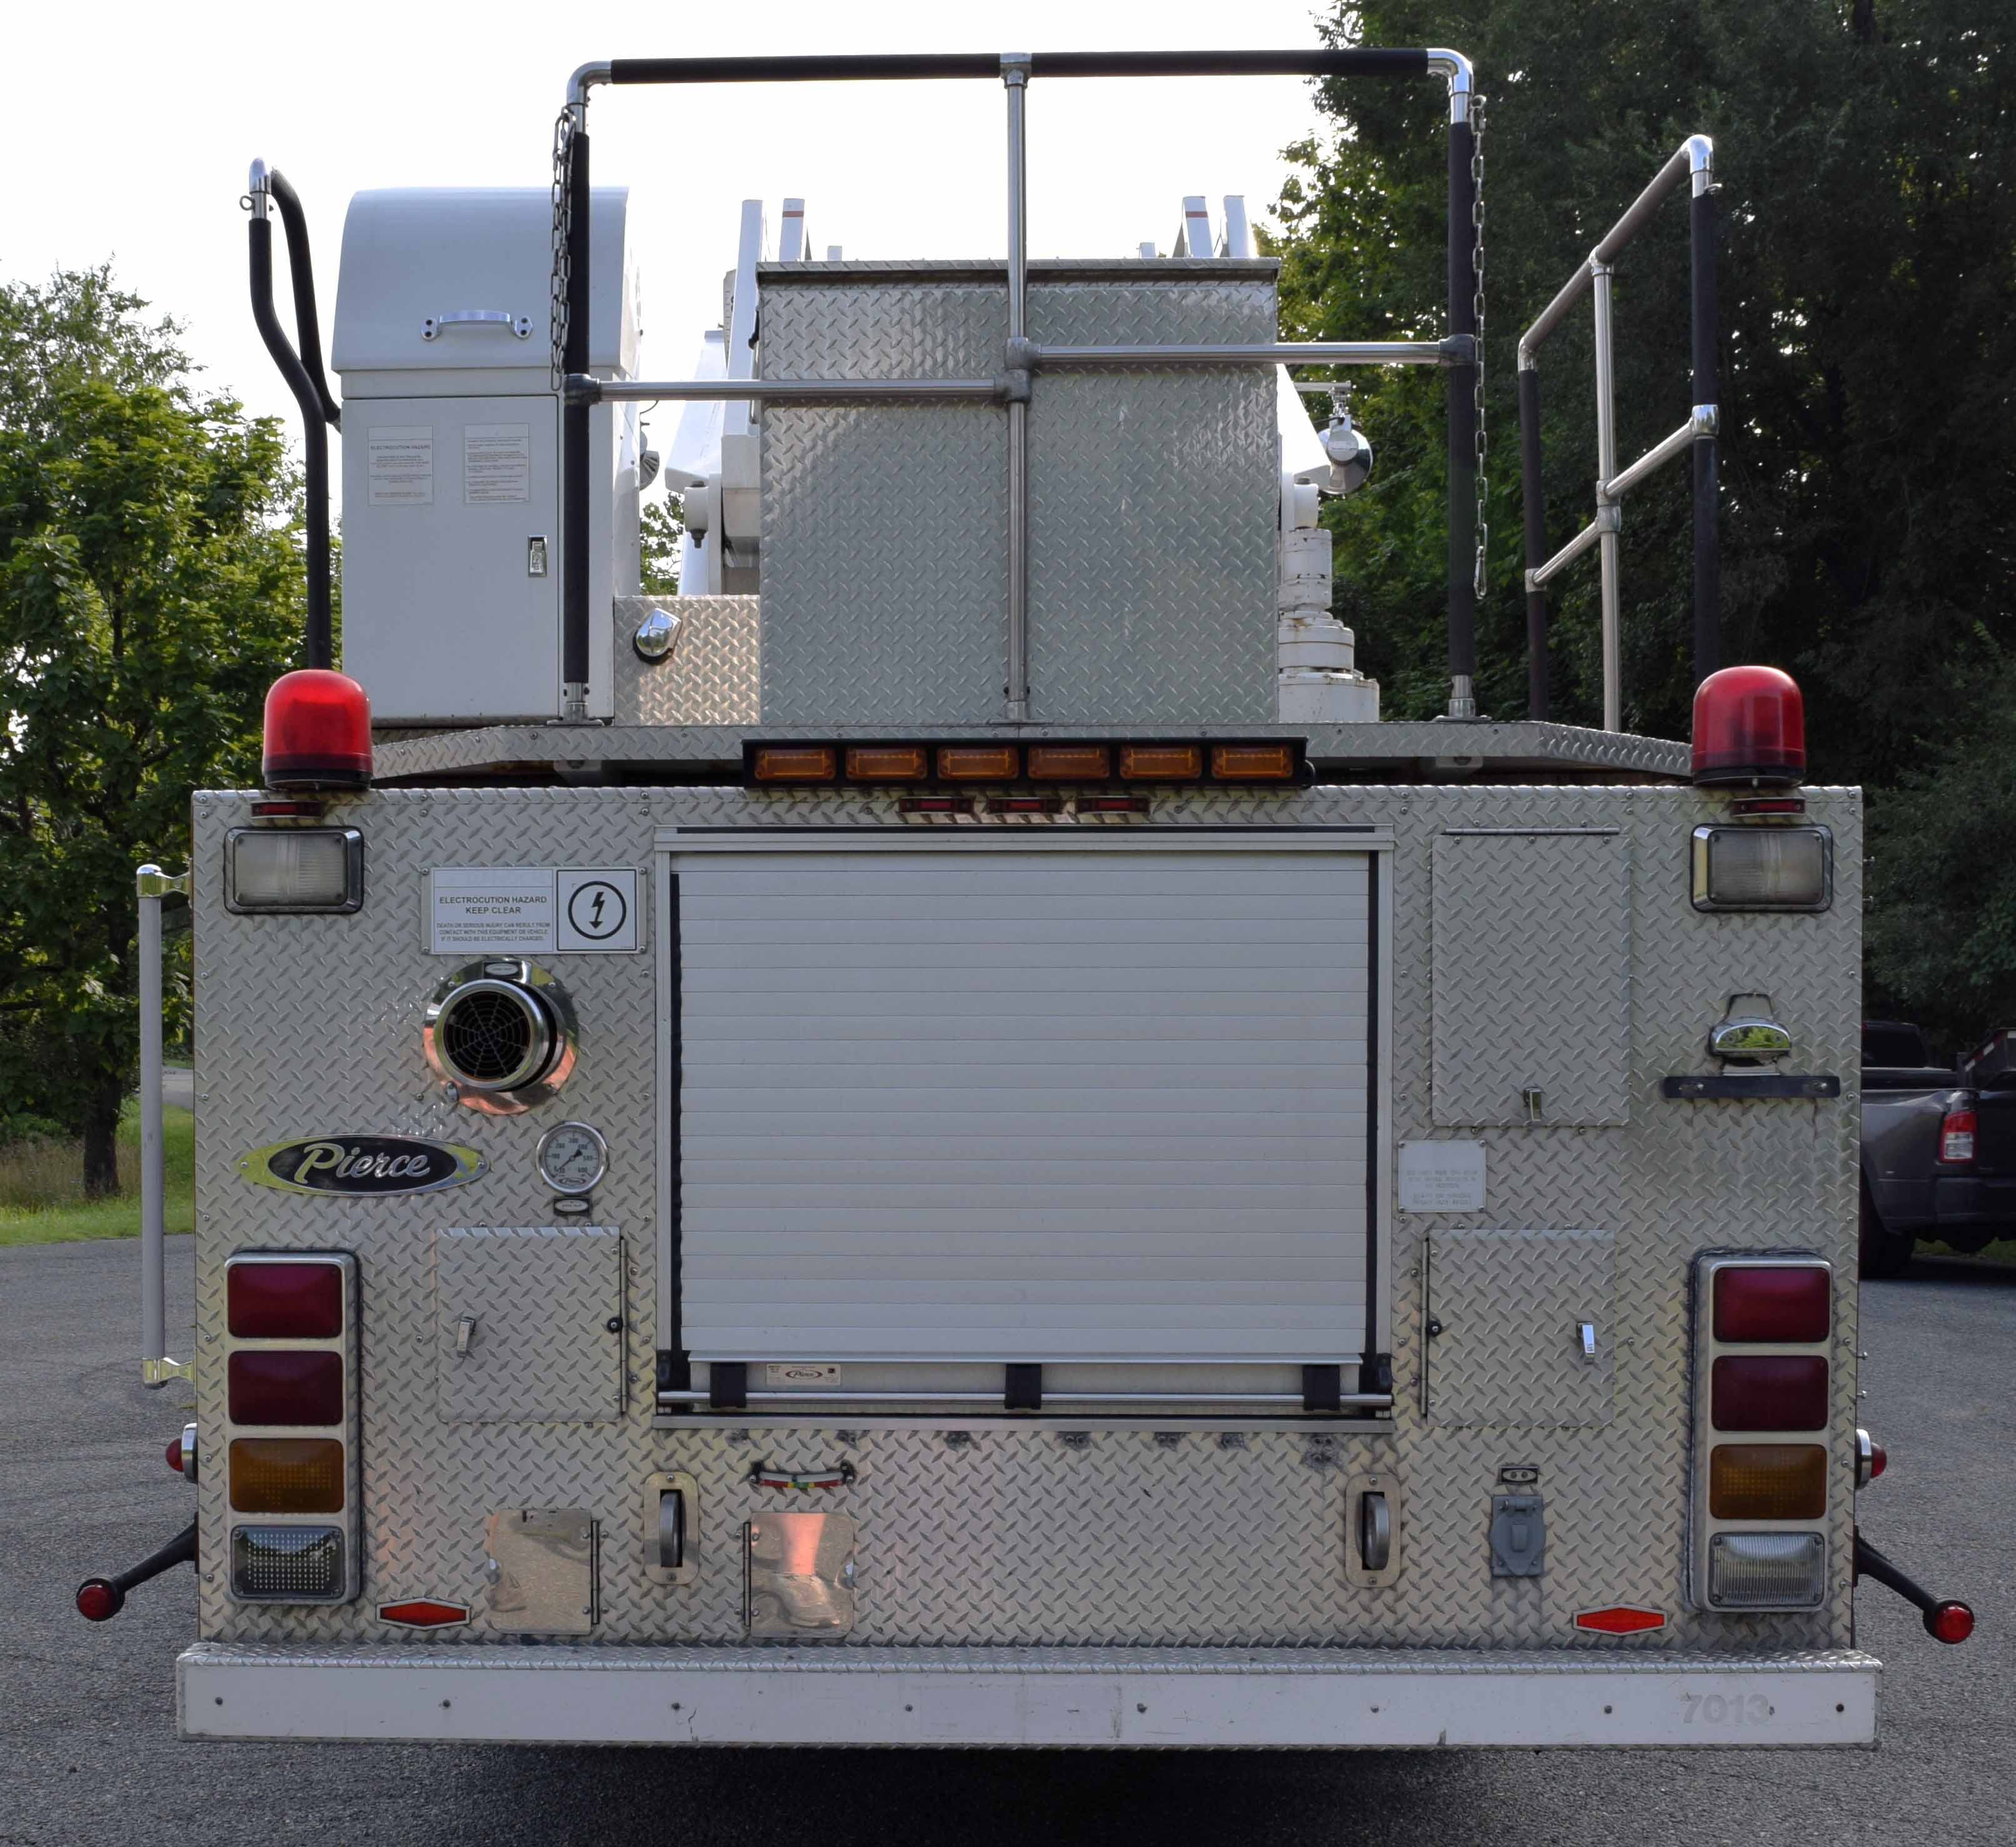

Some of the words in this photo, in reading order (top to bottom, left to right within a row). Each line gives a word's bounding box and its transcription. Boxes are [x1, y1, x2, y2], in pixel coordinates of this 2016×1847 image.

[439, 896, 510, 904] ELECTROCUTION
[294, 1142, 431, 1184] Pierce
[1680, 1694, 1770, 1724] 7013
